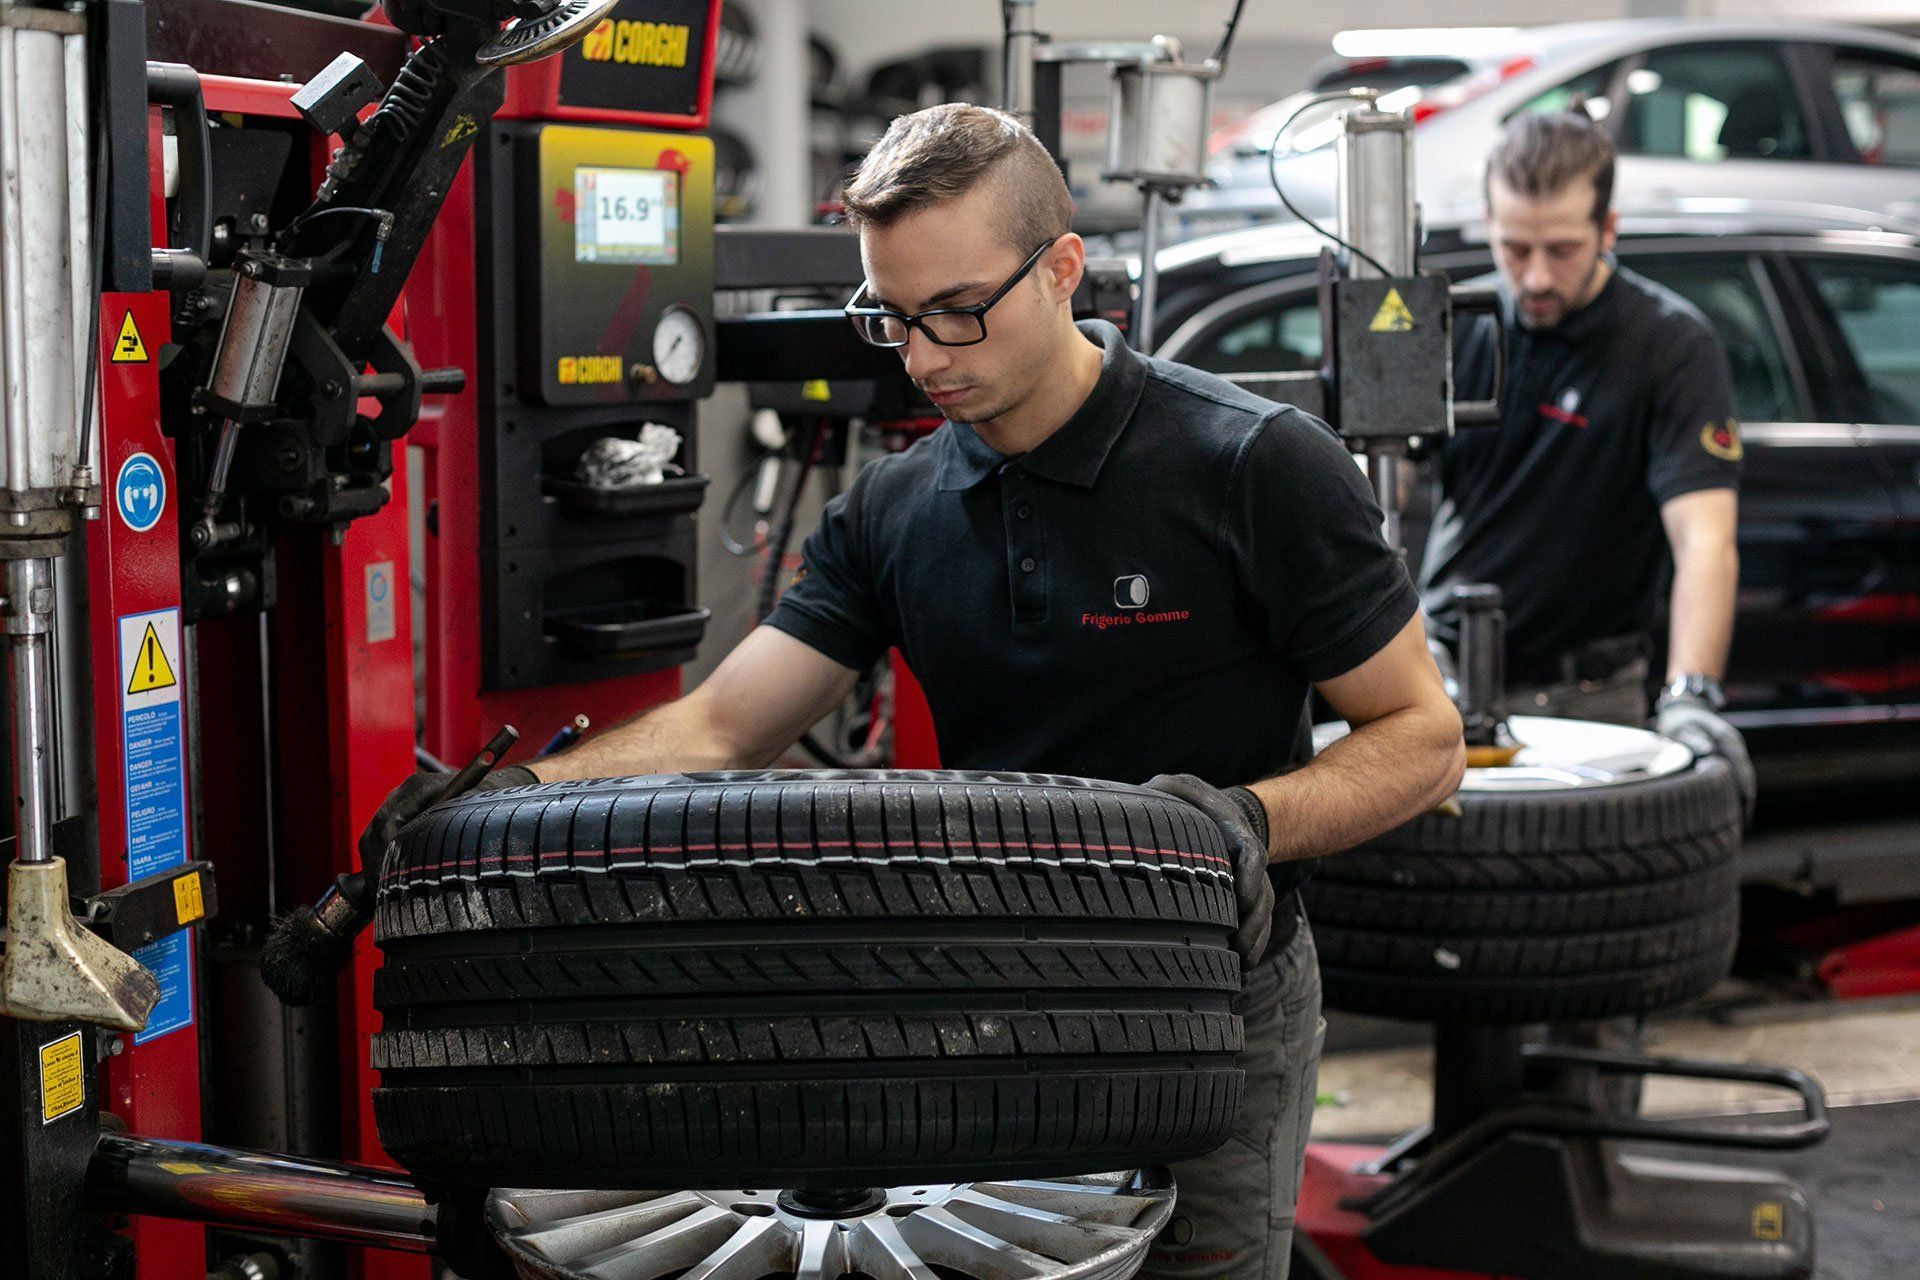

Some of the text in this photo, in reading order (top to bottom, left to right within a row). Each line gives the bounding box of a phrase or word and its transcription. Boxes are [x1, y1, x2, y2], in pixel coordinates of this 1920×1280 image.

[613, 19, 689, 68] CORGHI
[601, 197, 649, 220] 16.9
[1081, 609, 1190, 630] Frigerio Gomme
[127, 711, 156, 723] PERICOLO
[128, 738, 152, 750] DANGER
[129, 760, 153, 772] DANGER
[131, 806, 156, 818] PELIGRO
